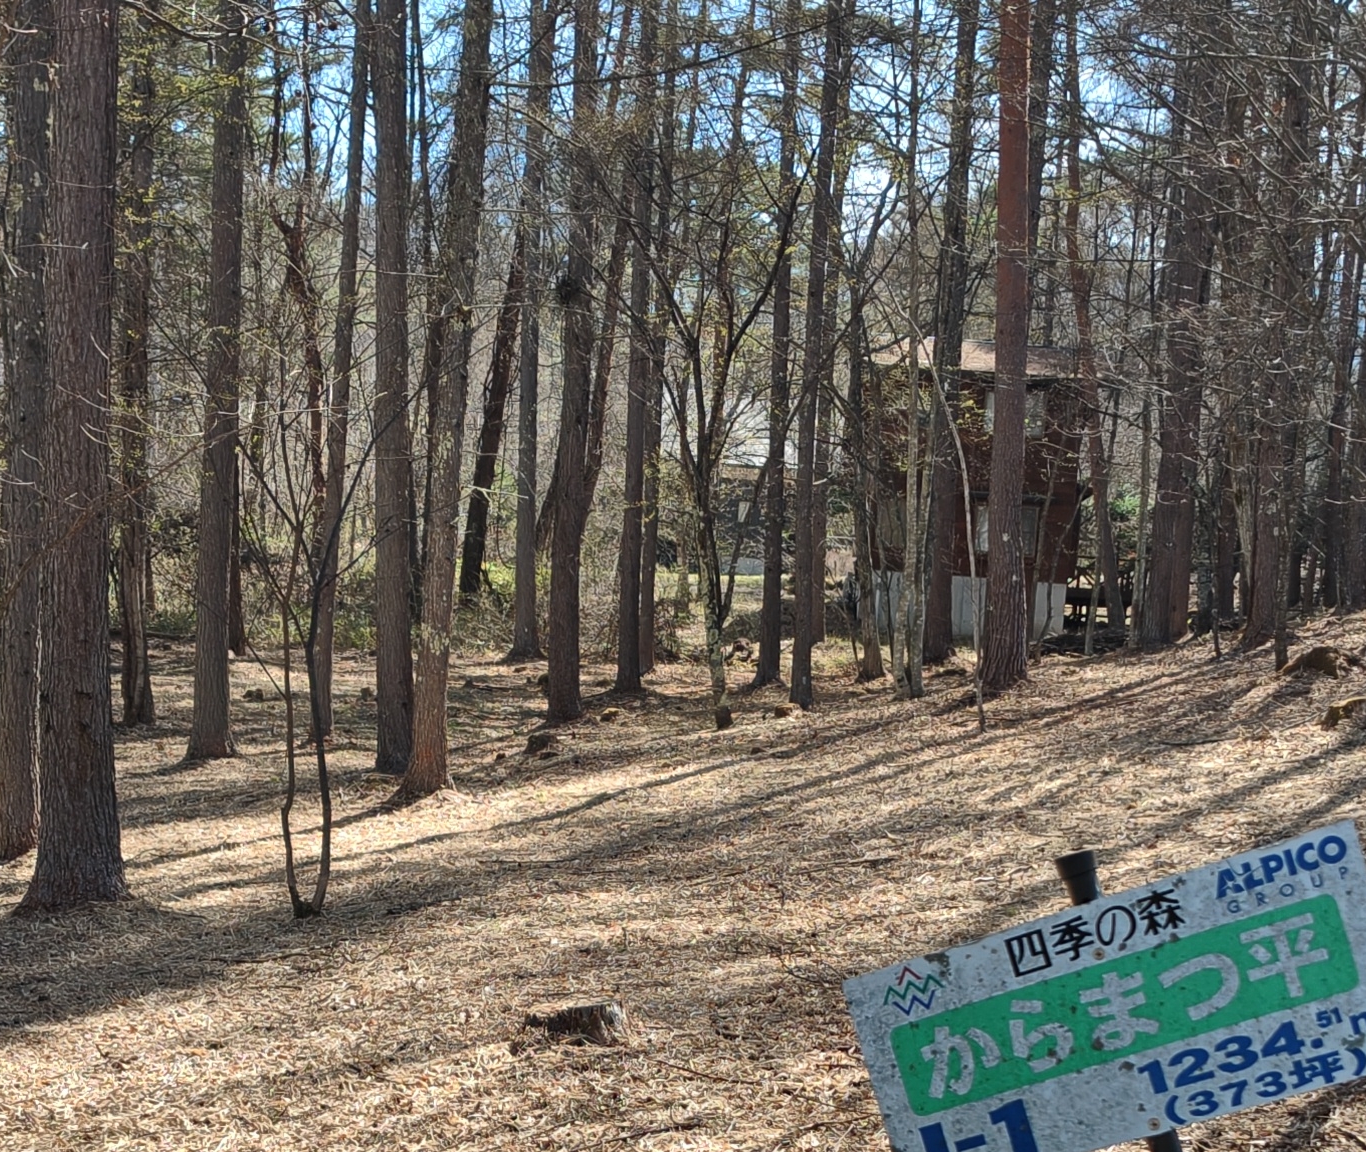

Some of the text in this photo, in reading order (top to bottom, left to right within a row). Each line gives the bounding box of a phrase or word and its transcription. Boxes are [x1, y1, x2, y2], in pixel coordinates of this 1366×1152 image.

[1216, 835, 1347, 899] ALPICO
[1227, 866, 1349, 914] GROUP
[1004, 888, 1186, 978] 四季の森
[920, 912, 1330, 1099] からまつ平
